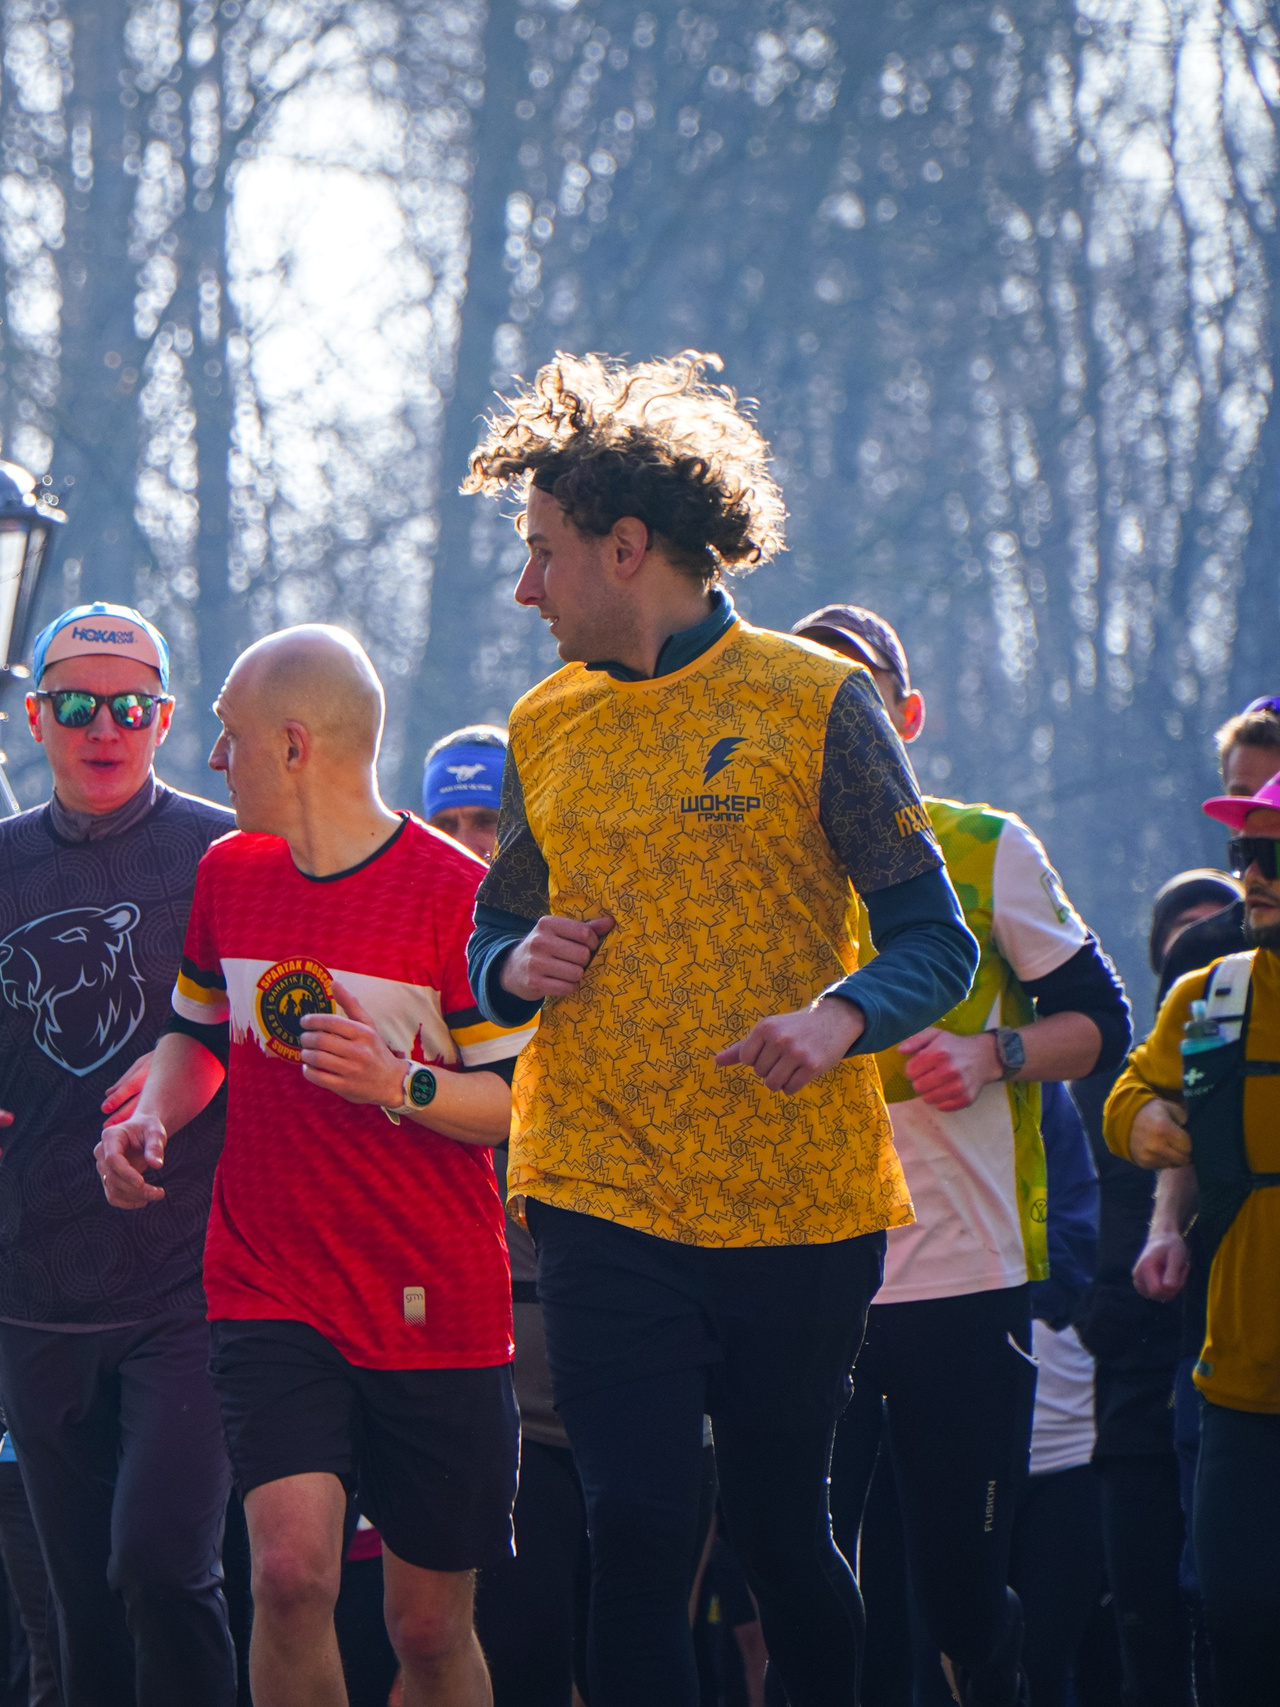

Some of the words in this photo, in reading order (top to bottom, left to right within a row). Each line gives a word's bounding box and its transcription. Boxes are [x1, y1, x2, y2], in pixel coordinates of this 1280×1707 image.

[72, 626, 117, 644] HOKA
[680, 794, 761, 813] ШОКЕР
[697, 812, 745, 823] ГРУППА
[260, 960, 302, 989] SPARTAK
[304, 961, 333, 996] MOSCOW
[271, 1039, 301, 1061] SUPPO
[984, 1480, 996, 1532] FUSION
